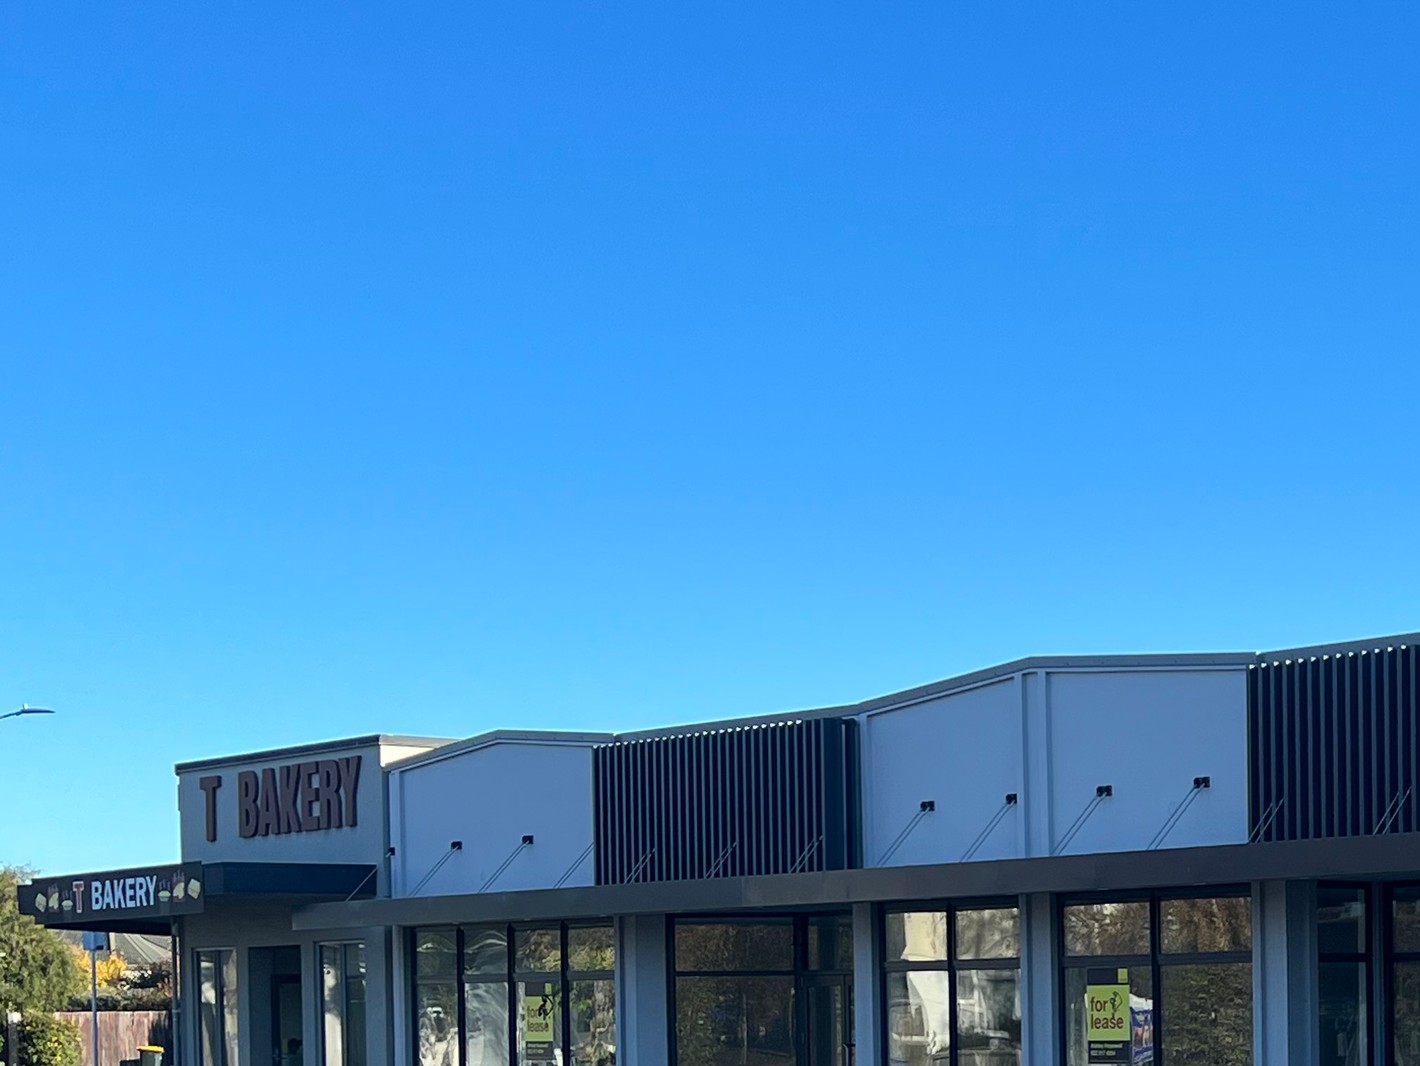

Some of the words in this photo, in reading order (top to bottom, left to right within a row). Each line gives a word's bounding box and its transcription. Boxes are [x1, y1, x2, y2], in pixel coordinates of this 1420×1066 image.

[199, 775, 222, 842] T
[238, 755, 362, 838] BAKERY
[72, 880, 85, 914] T
[91, 875, 158, 911] BAKERY
[527, 1005, 540, 1018] for
[1090, 996, 1108, 1012] for
[527, 1020, 550, 1032] lease
[1091, 1013, 1124, 1029] lease
